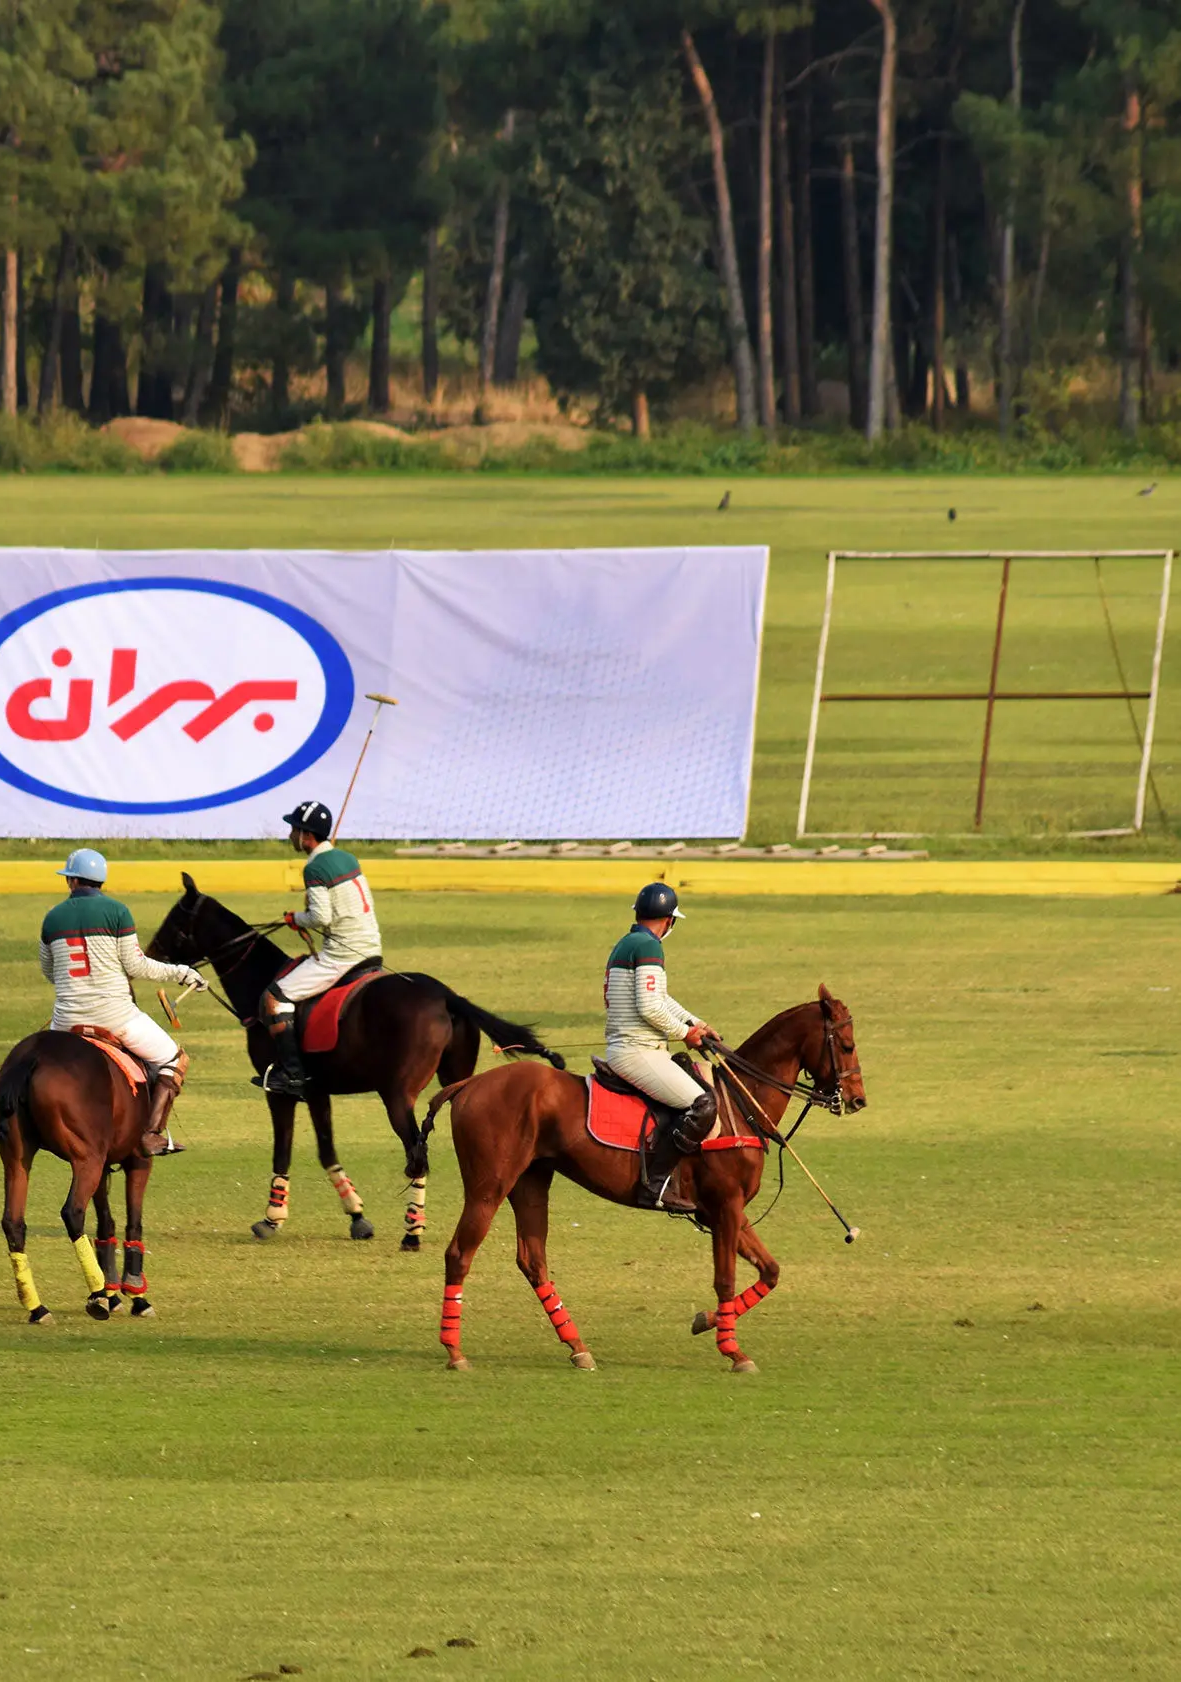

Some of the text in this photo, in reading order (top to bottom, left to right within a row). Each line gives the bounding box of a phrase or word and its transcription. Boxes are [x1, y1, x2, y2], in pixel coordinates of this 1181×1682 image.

[351, 877, 370, 914] 1
[65, 936, 91, 978] 3
[646, 975, 656, 992] 2
